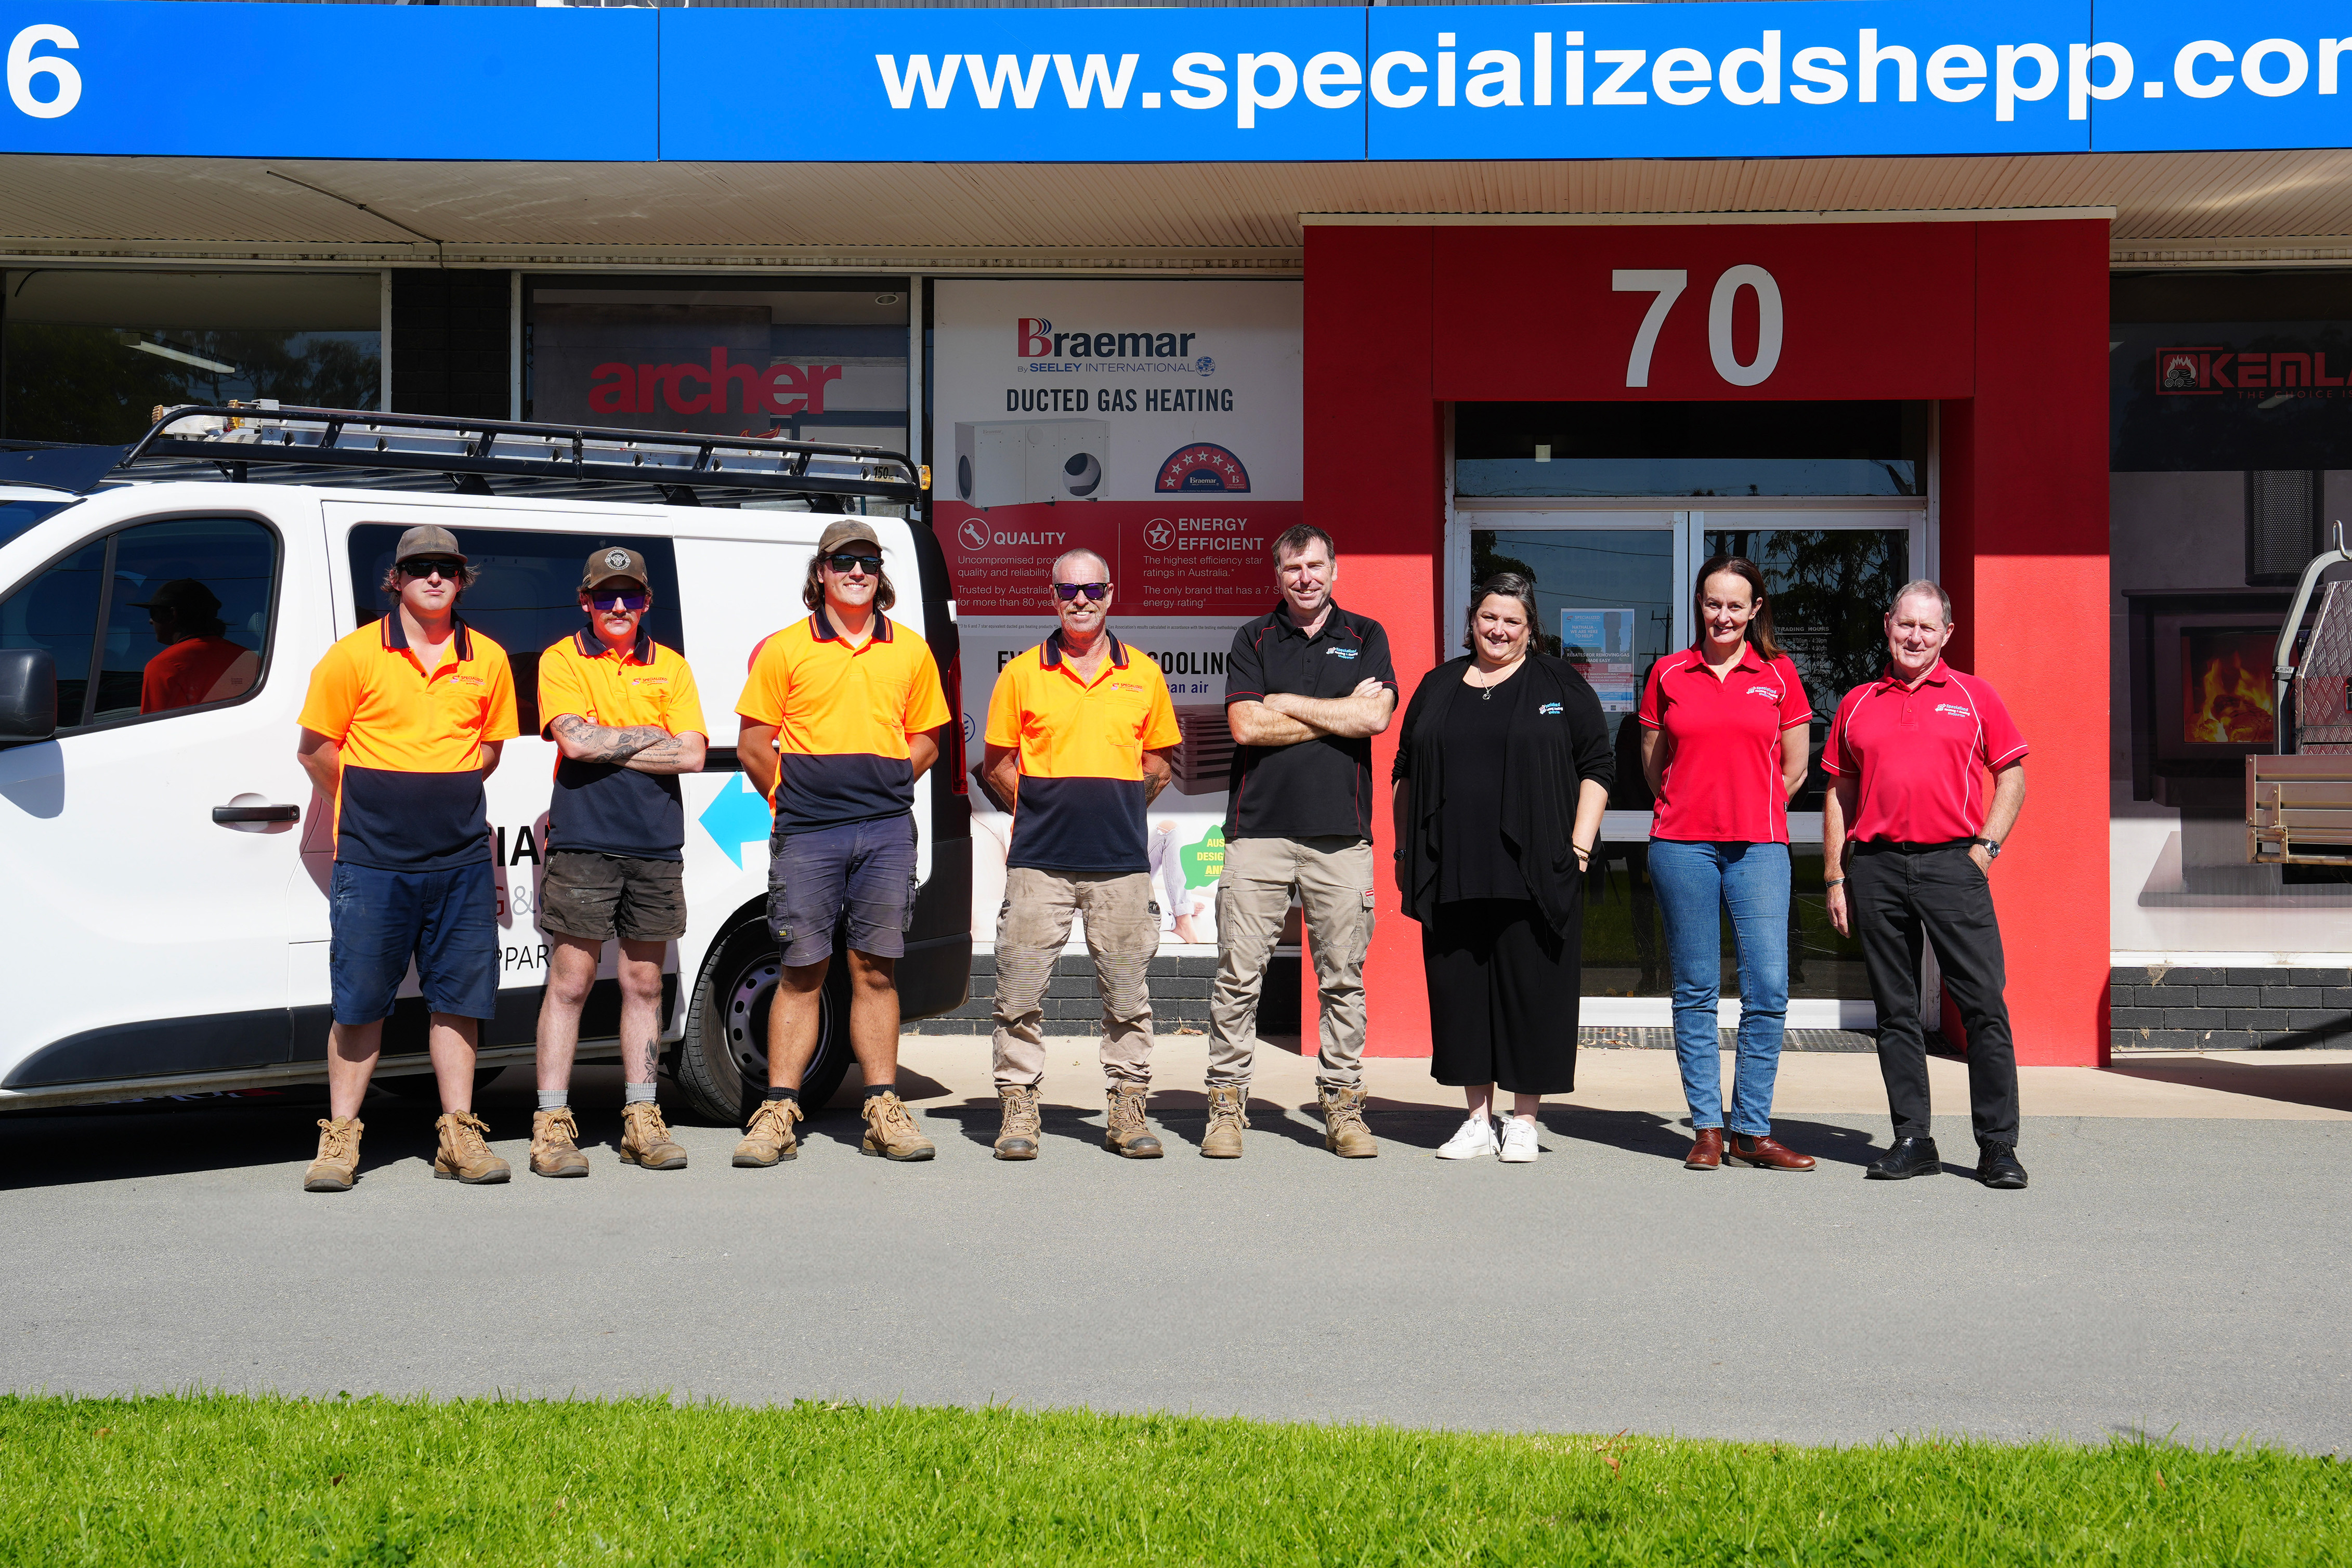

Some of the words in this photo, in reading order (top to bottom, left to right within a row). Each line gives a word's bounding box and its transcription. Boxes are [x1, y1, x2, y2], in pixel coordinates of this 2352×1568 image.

[7, 24, 82, 118] 6
[1612, 264, 1783, 388] 70
[1018, 318, 1195, 358] Braemar
[1030, 363, 1082, 372] SEELEY
[1086, 363, 1195, 372] INTERNATIONAL
[2200, 351, 2352, 388] KEML
[589, 347, 842, 415] archer
[1007, 389, 1088, 412] DUCTED
[1097, 388, 1137, 412] GAS
[1146, 388, 1233, 412] HEATING
[2275, 390, 2333, 399] CHOICE
[1178, 518, 1248, 531] ENERGY
[994, 532, 1066, 545] QUALITY
[1154, 530, 1165, 540] 7
[1178, 538, 1264, 550] EFFICIENT
[958, 555, 1034, 566] Uncompromised
[1143, 556, 1160, 565] The
[1164, 556, 1197, 566] highest
[1200, 556, 1242, 566] efficiency
[958, 568, 987, 578] quality
[990, 568, 1008, 577] and
[1011, 568, 1052, 578] reliability.
[1143, 568, 1174, 579] ratings
[1178, 568, 1185, 577] in
[958, 585, 992, 594] Trusted
[995, 585, 1006, 595] by
[1143, 585, 1160, 594] The
[1163, 585, 1182, 596] only
[1185, 585, 1212, 594] brand
[1215, 586, 1233, 594] that
[1236, 586, 1252, 594] has
[1264, 586, 1270, 594] 7
[958, 598, 970, 606] for
[1143, 600, 1174, 608] energy
[1191, 681, 1209, 693] air
[512, 886, 537, 916] &
